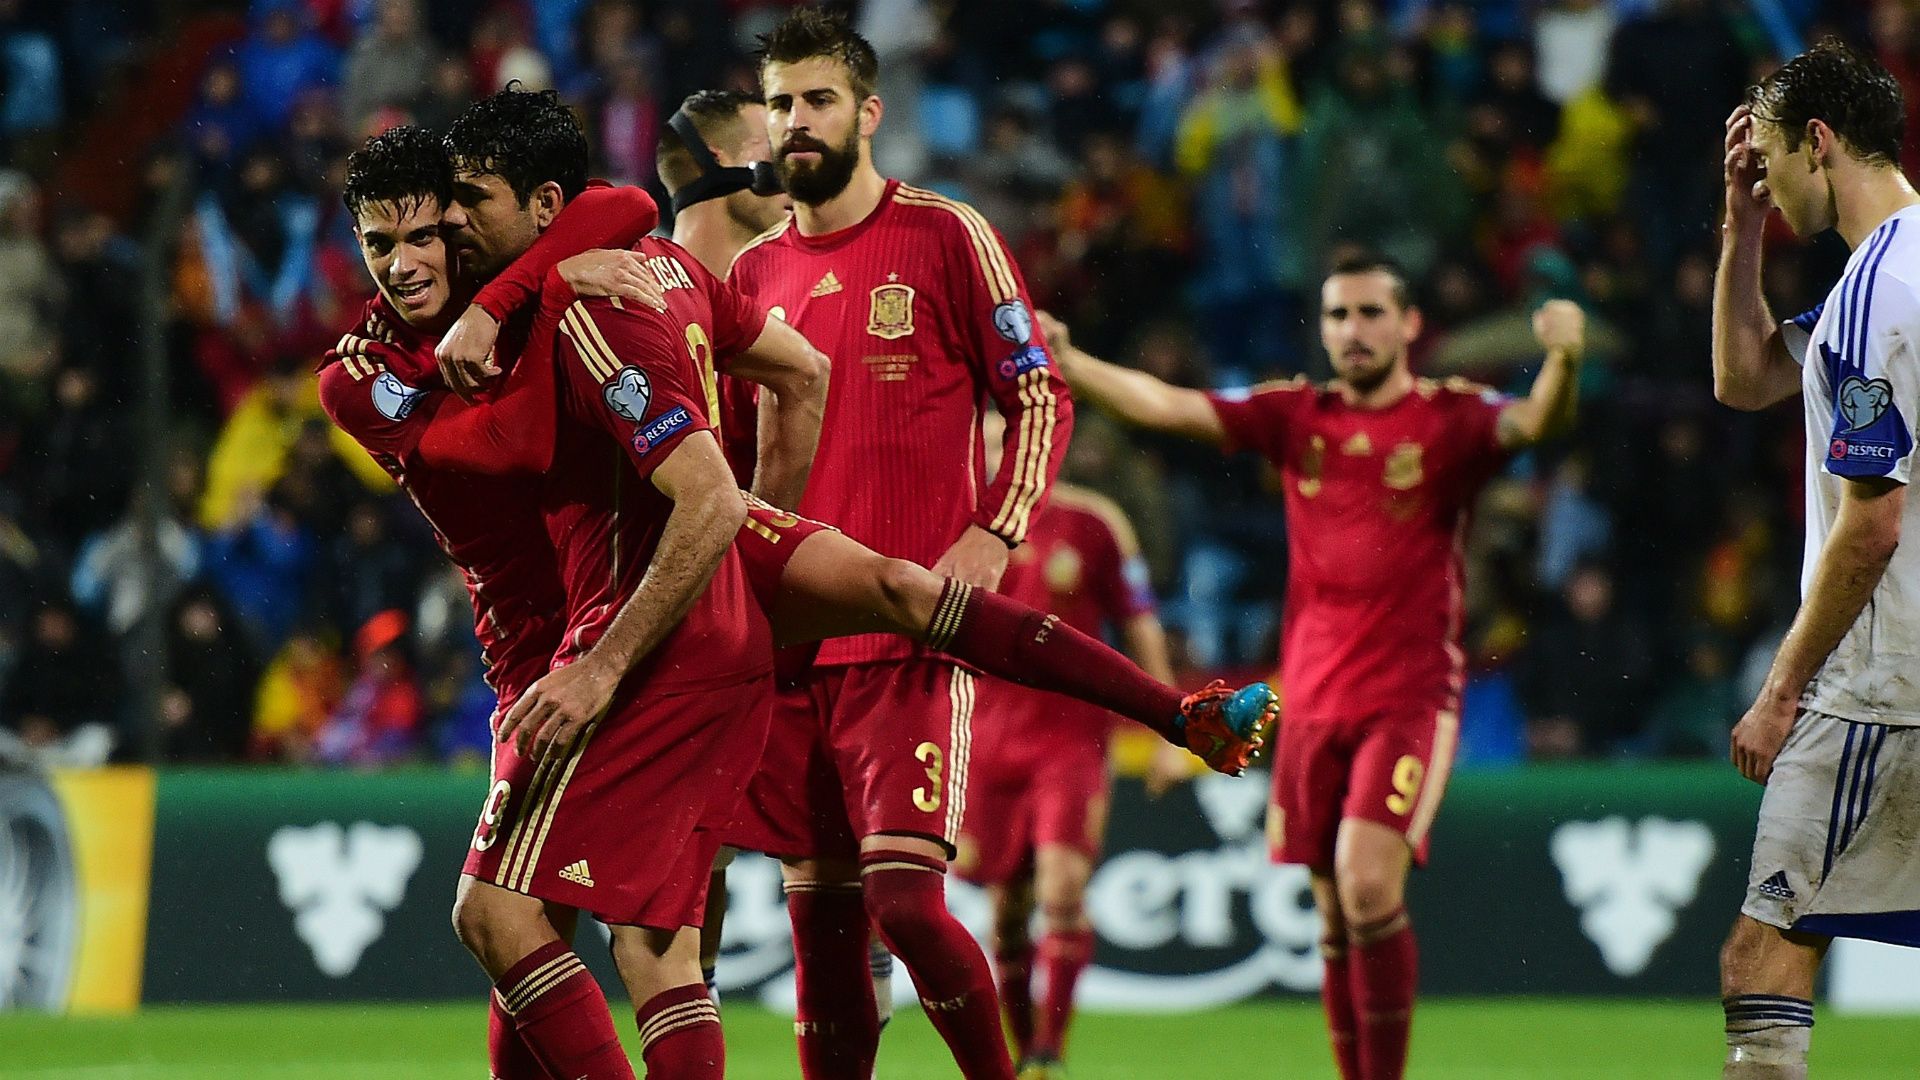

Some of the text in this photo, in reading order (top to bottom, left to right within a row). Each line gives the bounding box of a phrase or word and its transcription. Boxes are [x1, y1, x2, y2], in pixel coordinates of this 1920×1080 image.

[645, 410, 688, 441] RESPECT
[1847, 444, 1895, 458] RESPECT
[912, 741, 944, 813] 3
[1385, 754, 1424, 816] 9
[558, 869, 595, 888] adidas
